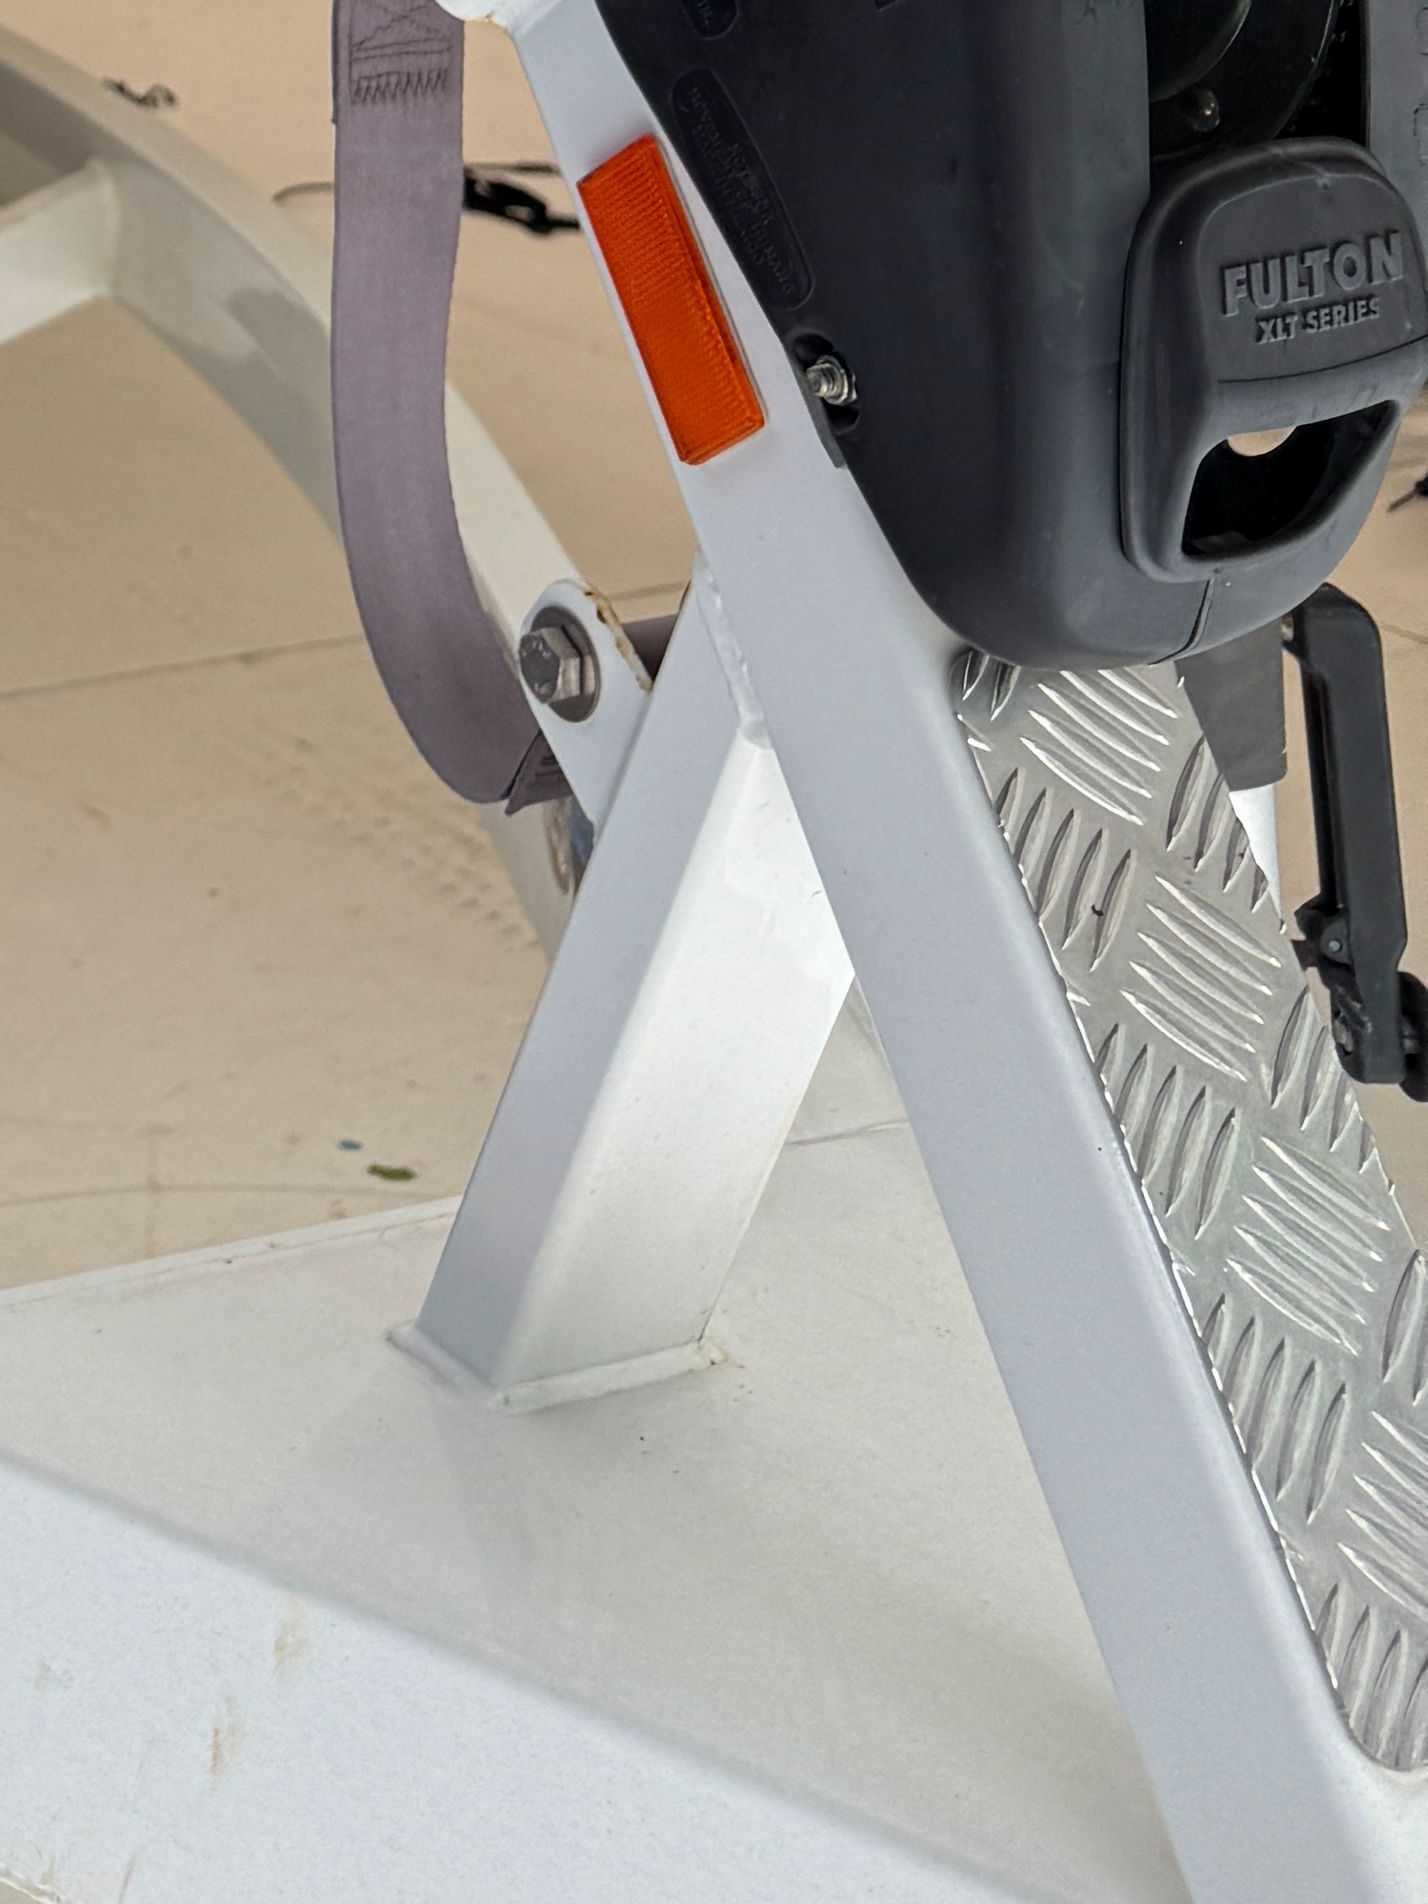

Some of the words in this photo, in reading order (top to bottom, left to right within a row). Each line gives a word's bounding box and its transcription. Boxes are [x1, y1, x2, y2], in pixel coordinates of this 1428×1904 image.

[1222, 229, 1404, 318] FULTON
[1255, 312, 1299, 345] XLT
[1302, 293, 1381, 335] SERIES
